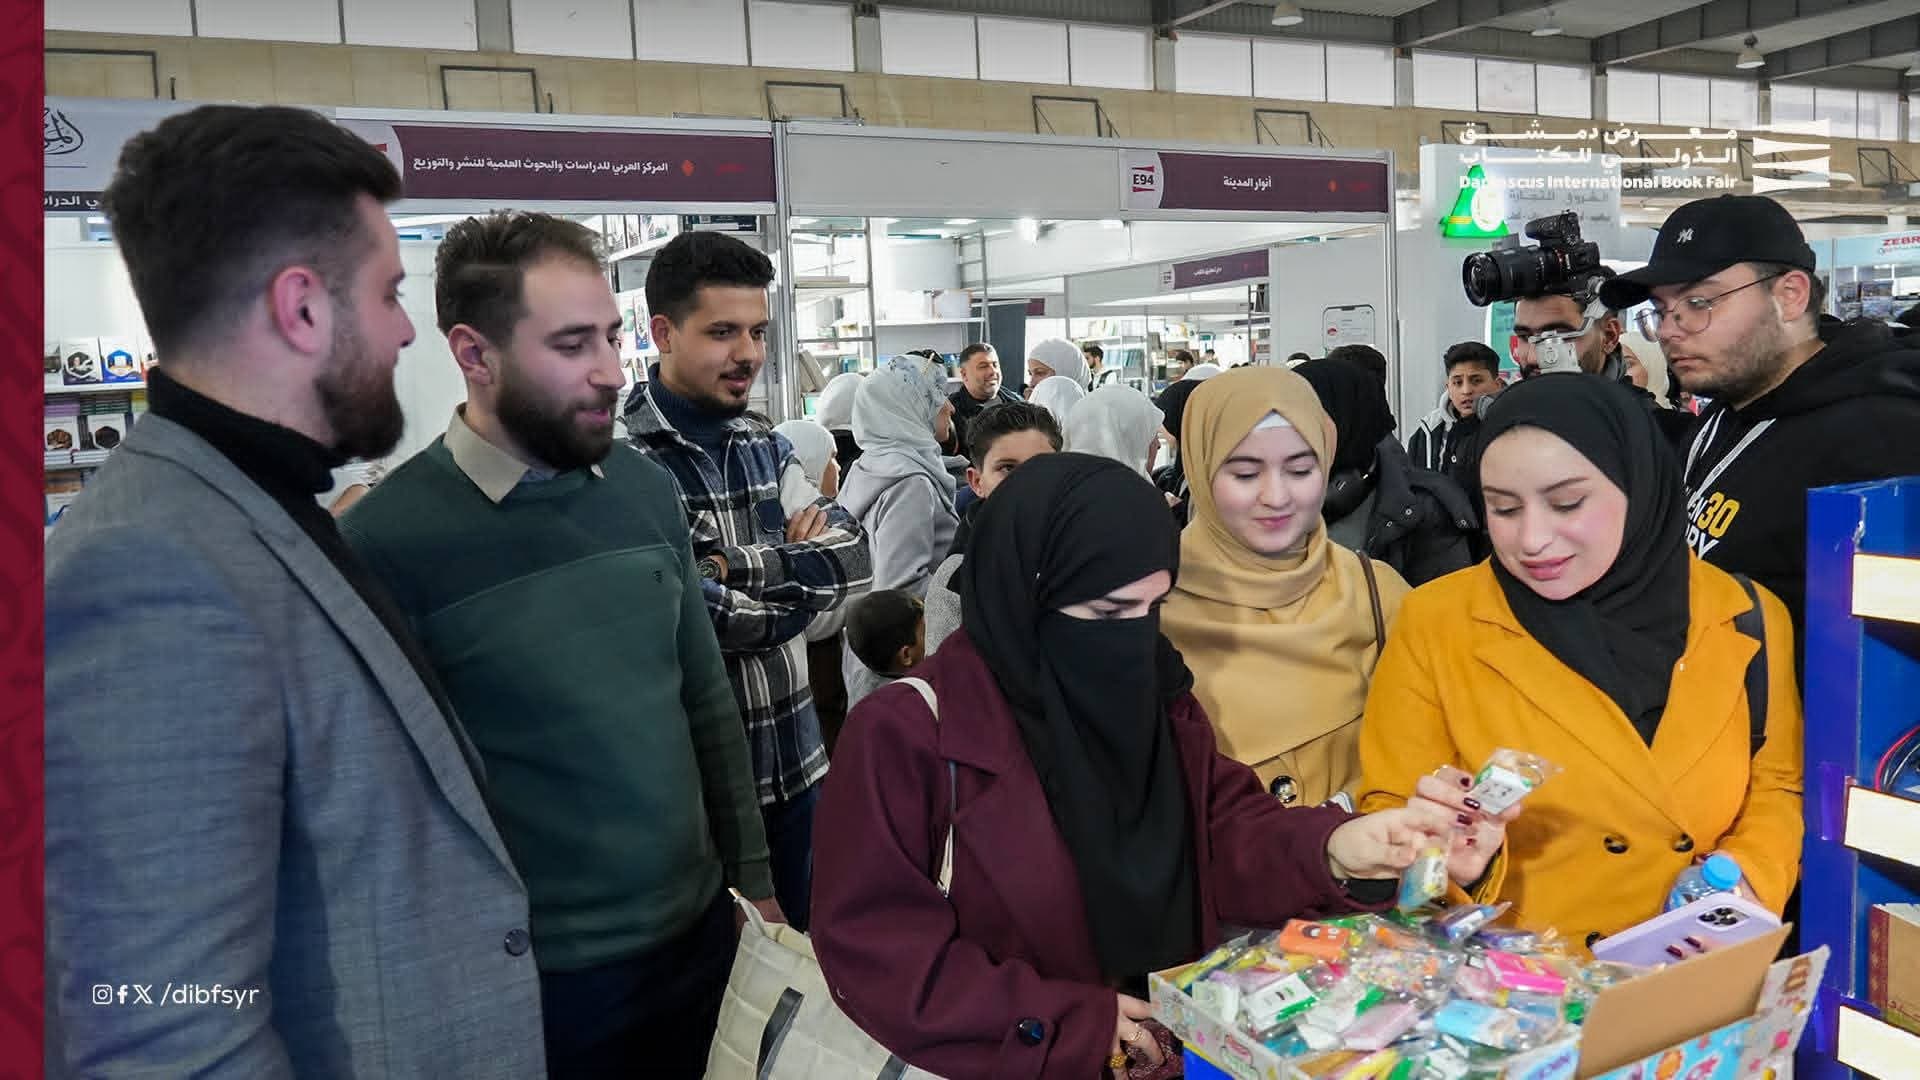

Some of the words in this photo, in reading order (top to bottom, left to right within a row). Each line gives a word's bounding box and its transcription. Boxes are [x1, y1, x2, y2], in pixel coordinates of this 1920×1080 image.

[413, 158, 454, 170] والتوزيع
[456, 156, 484, 170] للنشر
[487, 159, 521, 170] العلمية
[523, 158, 563, 172] والبحوث
[565, 161, 610, 172] للدراسات
[612, 162, 640, 175] العربي
[642, 162, 668, 174] المركز
[1133, 174, 1154, 185] E94
[1224, 176, 1253, 189] المدينة
[1254, 175, 1271, 190] أنوار
